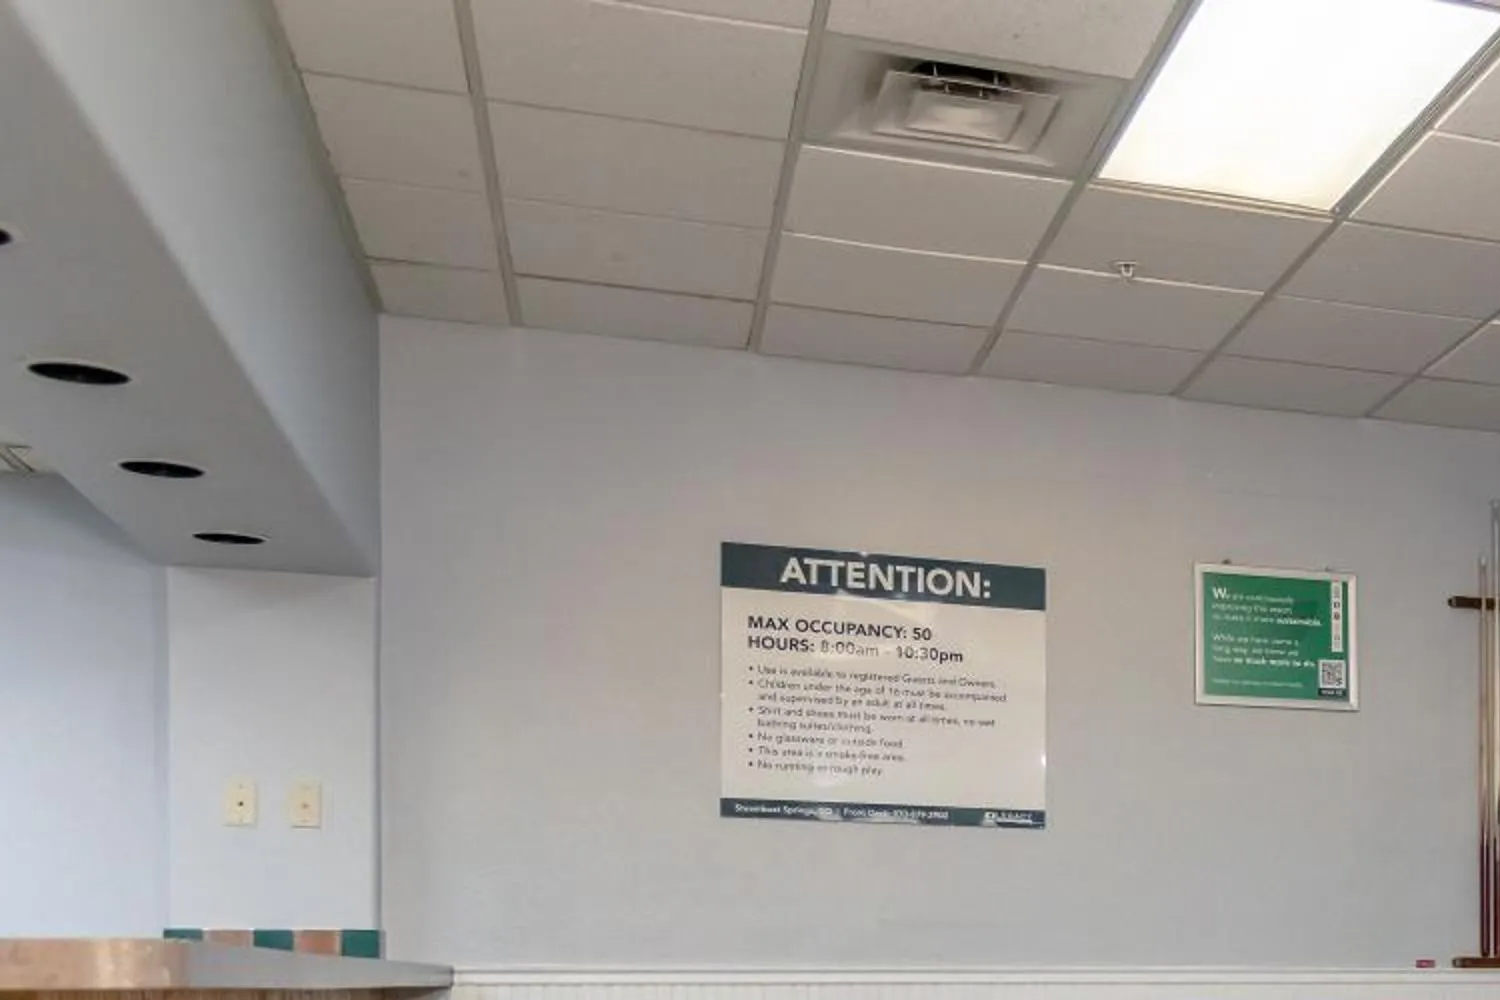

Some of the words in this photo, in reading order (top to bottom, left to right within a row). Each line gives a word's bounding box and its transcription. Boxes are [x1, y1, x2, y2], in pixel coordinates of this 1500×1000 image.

[779, 557, 992, 599] ATTENTION:
[747, 615, 790, 631] MAX
[795, 619, 908, 640] OCCUPANCY:
[912, 627, 933, 641] 50
[748, 635, 815, 653] HOURS:
[896, 645, 964, 664] 10:30pm
